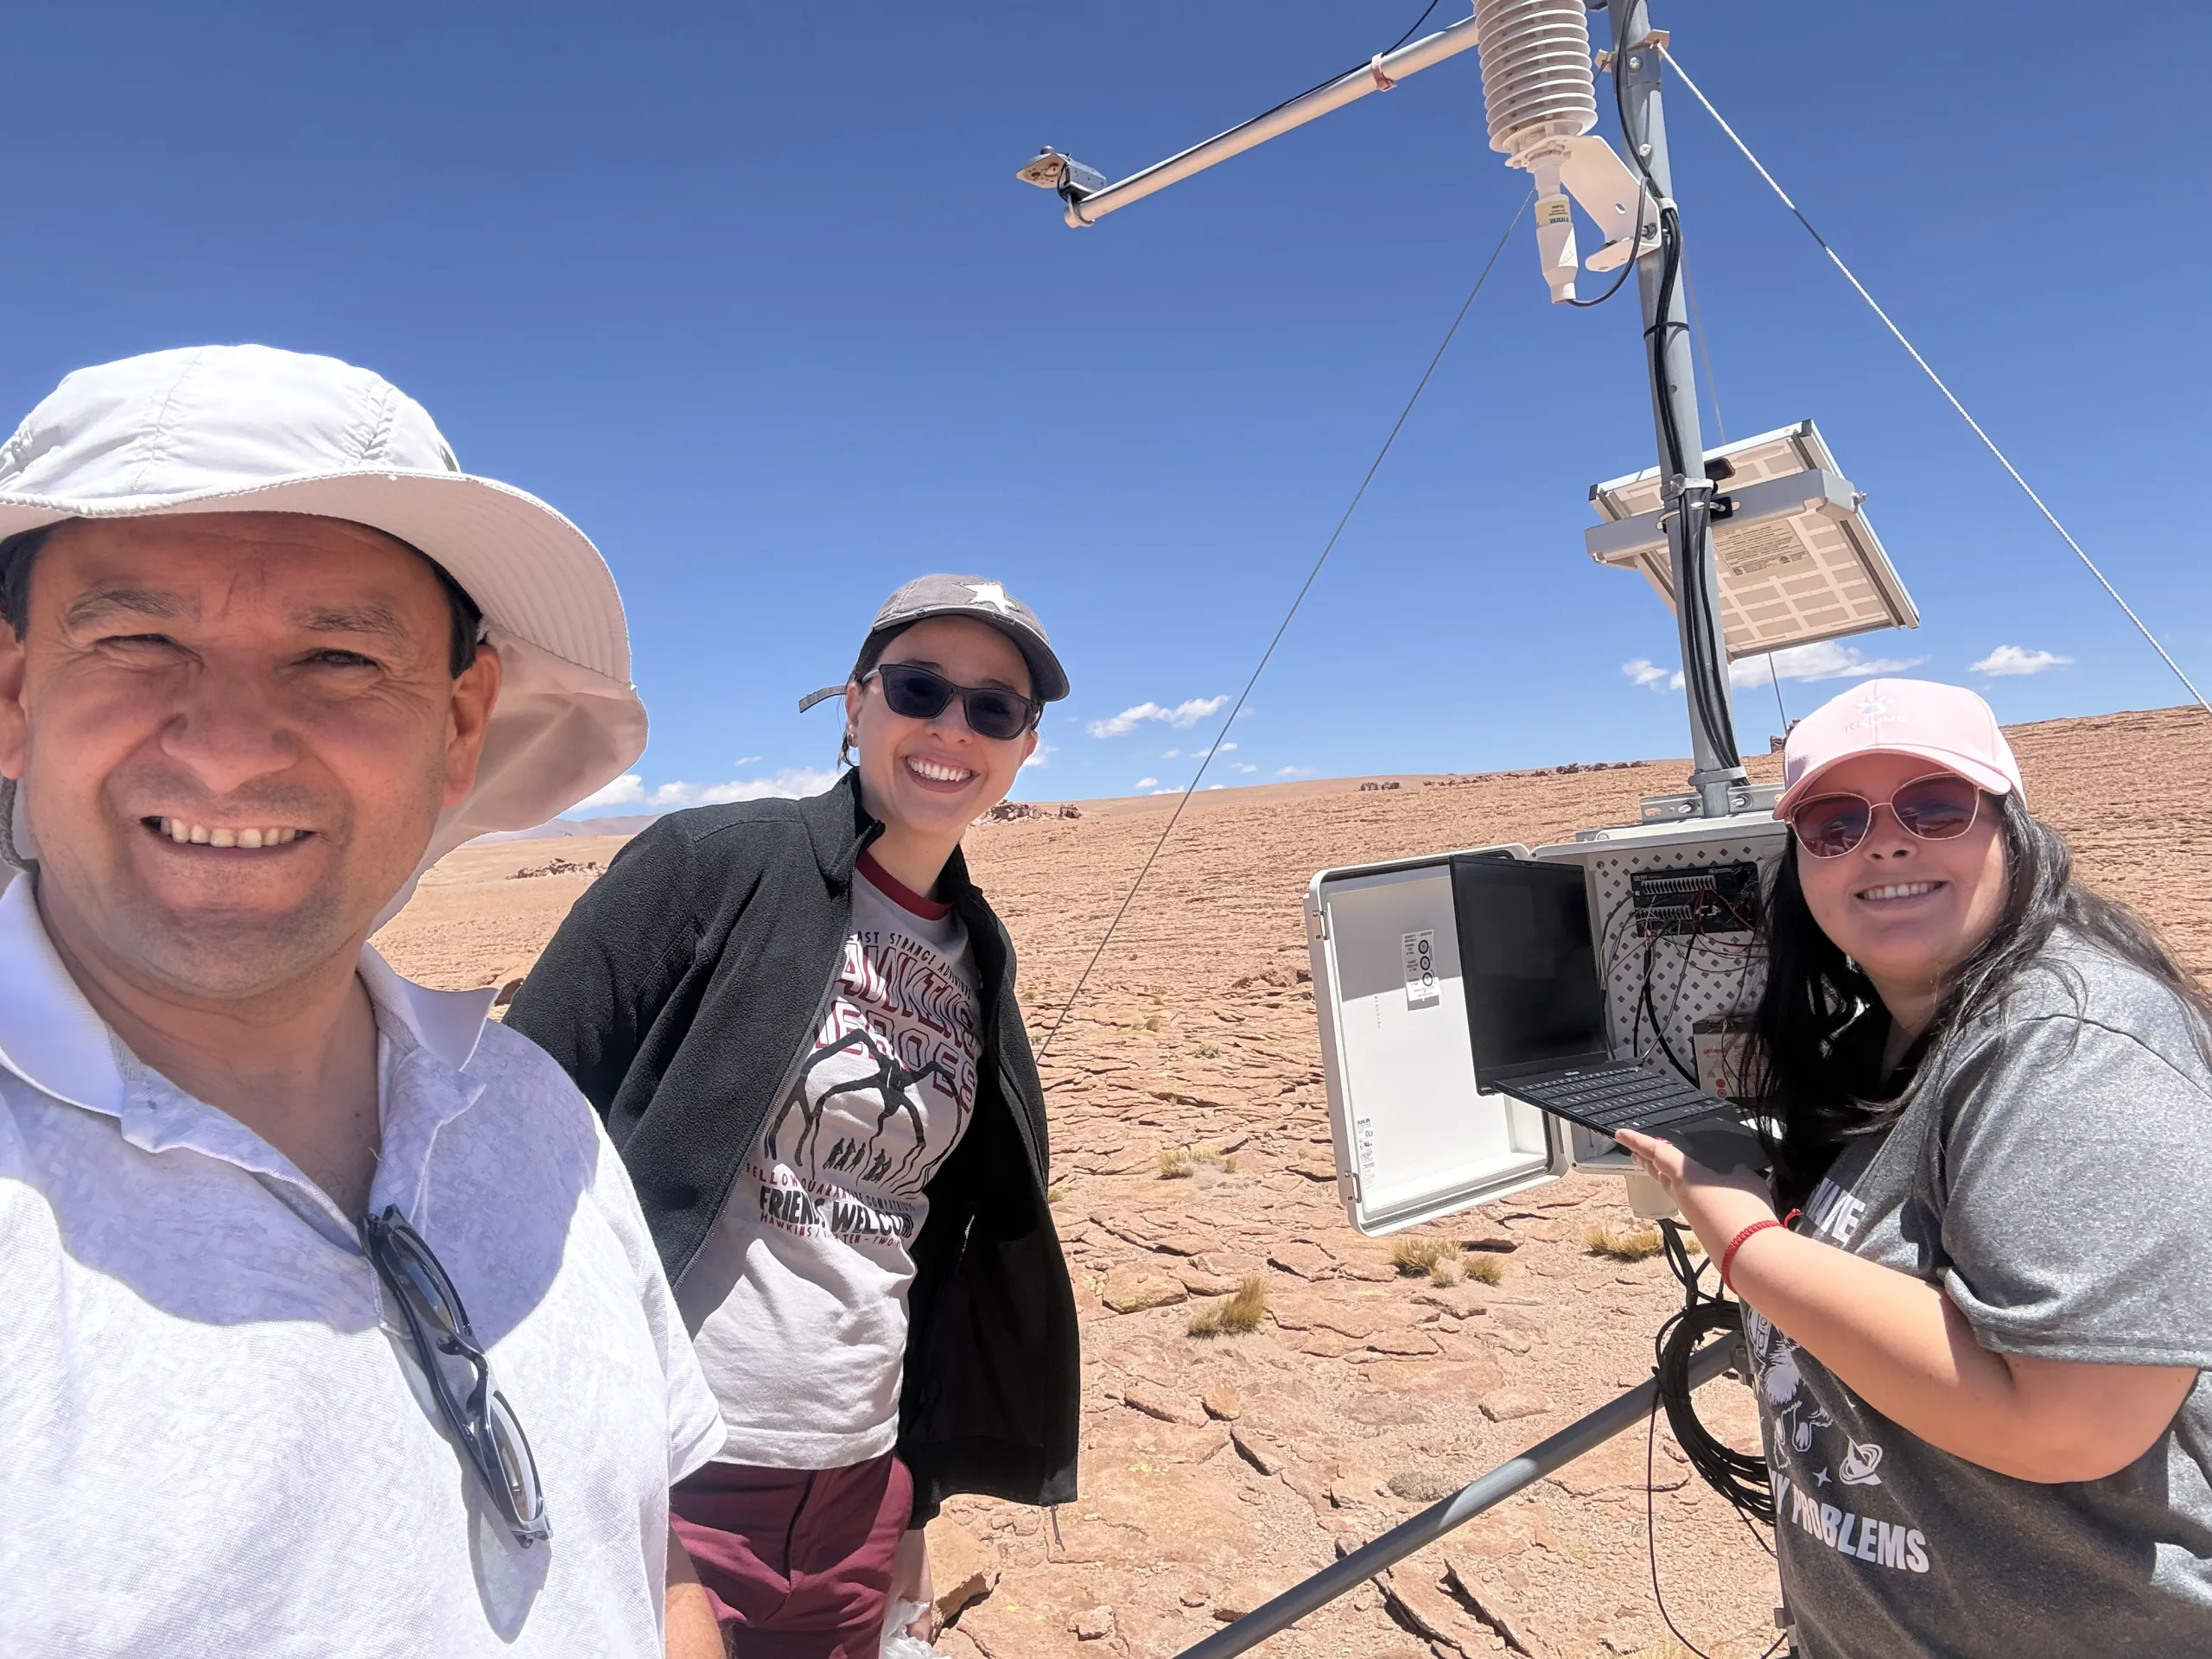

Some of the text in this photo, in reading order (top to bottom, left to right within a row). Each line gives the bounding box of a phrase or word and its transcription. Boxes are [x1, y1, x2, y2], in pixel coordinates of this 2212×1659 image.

[850, 931, 880, 944] AST
[889, 932, 937, 965] STRANGE
[760, 1211, 811, 1236] HAWKINS
[873, 1236, 893, 1247] TWO
[1791, 1484, 1930, 1573] PROBLEMS
